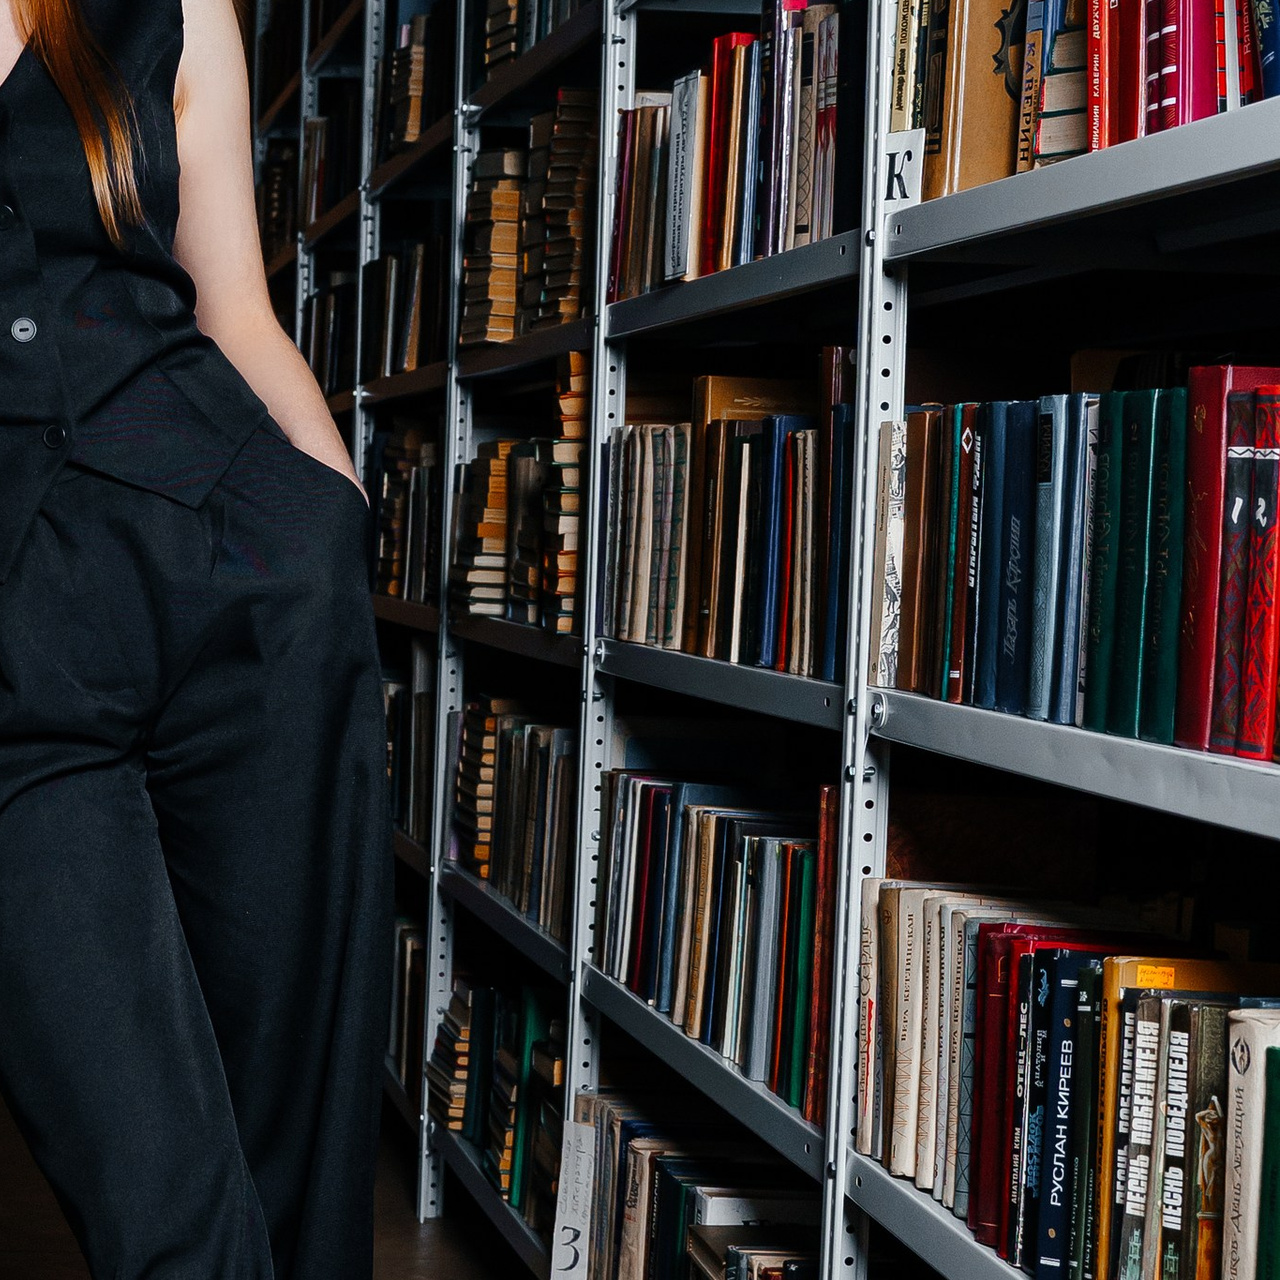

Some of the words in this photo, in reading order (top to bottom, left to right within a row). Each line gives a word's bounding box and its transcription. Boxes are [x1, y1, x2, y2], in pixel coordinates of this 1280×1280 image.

[1019, 42, 1036, 162] КАВЕРИН
[1091, 53, 1100, 98] КАВЕРИН
[884, 150, 913, 201] К
[1231, 496, 1243, 524] 1
[1255, 497, 1267, 527] 2
[902, 913, 915, 1003] КЕТЛИНСКАЯ
[923, 920, 933, 1012] КЕТЛИНСКАЯ
[938, 925, 947, 1020] КЕТЛИНСКАЯ
[952, 928, 964, 1023] КЕТЛИНСКАЯ
[899, 1008, 910, 1042] ВЕРА
[921, 1016, 931, 1050] ВЕРА
[937, 1026, 945, 1059] ВЕРА
[950, 1030, 959, 1065] ВЕРА
[1057, 1039, 1074, 1119] КИРЕЕВ
[1130, 1019, 1160, 1146] ПОБЕДИТЕЛЯ
[1164, 1030, 1189, 1158] ПОБЕДИТЕЛЯ
[1013, 1127, 1021, 1150] КИМ
[1232, 1086, 1246, 1178] ЛЕТЯЩИЙ
[1010, 1153, 1020, 1204] АНАТОЛИЙ
[1050, 1124, 1068, 1207] РУСЛАН
[1125, 1153, 1150, 1218] ПЕСНЬ
[1162, 1165, 1184, 1231] ПЕСНЬ
